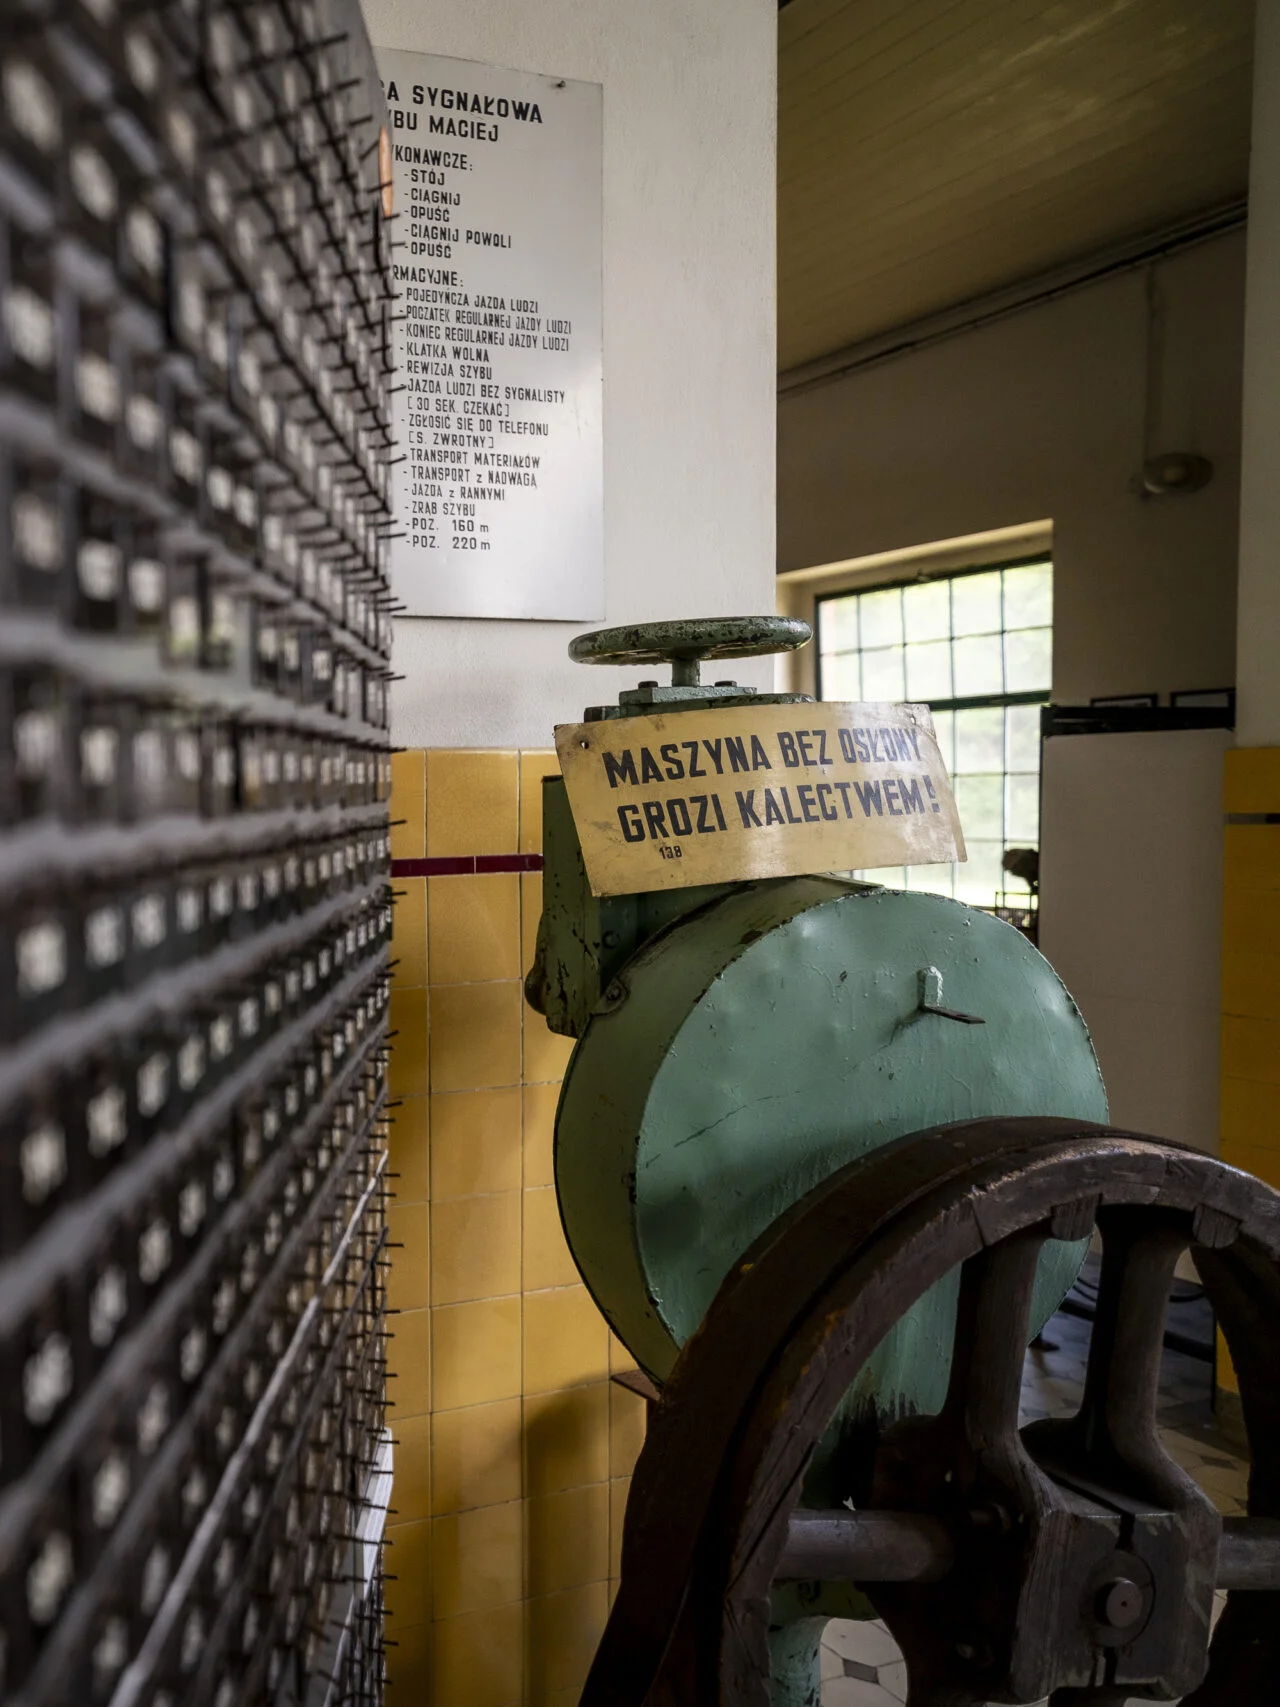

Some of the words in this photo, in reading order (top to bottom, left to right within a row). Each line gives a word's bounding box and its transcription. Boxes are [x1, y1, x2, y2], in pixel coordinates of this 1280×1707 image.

[413, 85, 542, 123] SYGNAŁOWA
[389, 109, 416, 131] BU
[430, 115, 499, 142] MACIEJ
[392, 145, 472, 171] KONAWCZE:
[466, 230, 511, 249] POWOLI
[474, 295, 505, 311] JAZDA
[511, 299, 538, 313] LUDZI
[456, 311, 510, 329] REGULARNEJ
[516, 317, 541, 331] JAZDY
[547, 320, 571, 334] LUDZI
[445, 328, 504, 346] REGULARNEJ
[509, 334, 537, 349] JAZDY
[543, 337, 569, 351] LUDZI
[452, 346, 489, 362] WOLNA
[460, 365, 492, 380] SZYBU
[447, 382, 475, 397] LUDZI
[481, 385, 500, 399] BEZ
[505, 387, 565, 404] SYGNALISTY
[457, 419, 473, 432] SIĘ
[479, 419, 492, 432] DO
[499, 420, 549, 436] TELEFONU
[474, 452, 540, 469] MATERIAŁÓW
[461, 487, 505, 501] RANNYMI
[443, 503, 475, 516] SZYBU
[452, 520, 474, 532] 160
[480, 524, 489, 532] m
[452, 537, 476, 550] 220
[481, 541, 490, 550] m
[602, 734, 771, 788] MASZYNA
[777, 730, 833, 767] BEZ
[838, 727, 922, 763] OSŁONY
[617, 794, 727, 843] GROZI
[735, 775, 940, 829] KALECTWEM!
[659, 845, 682, 859] 138
